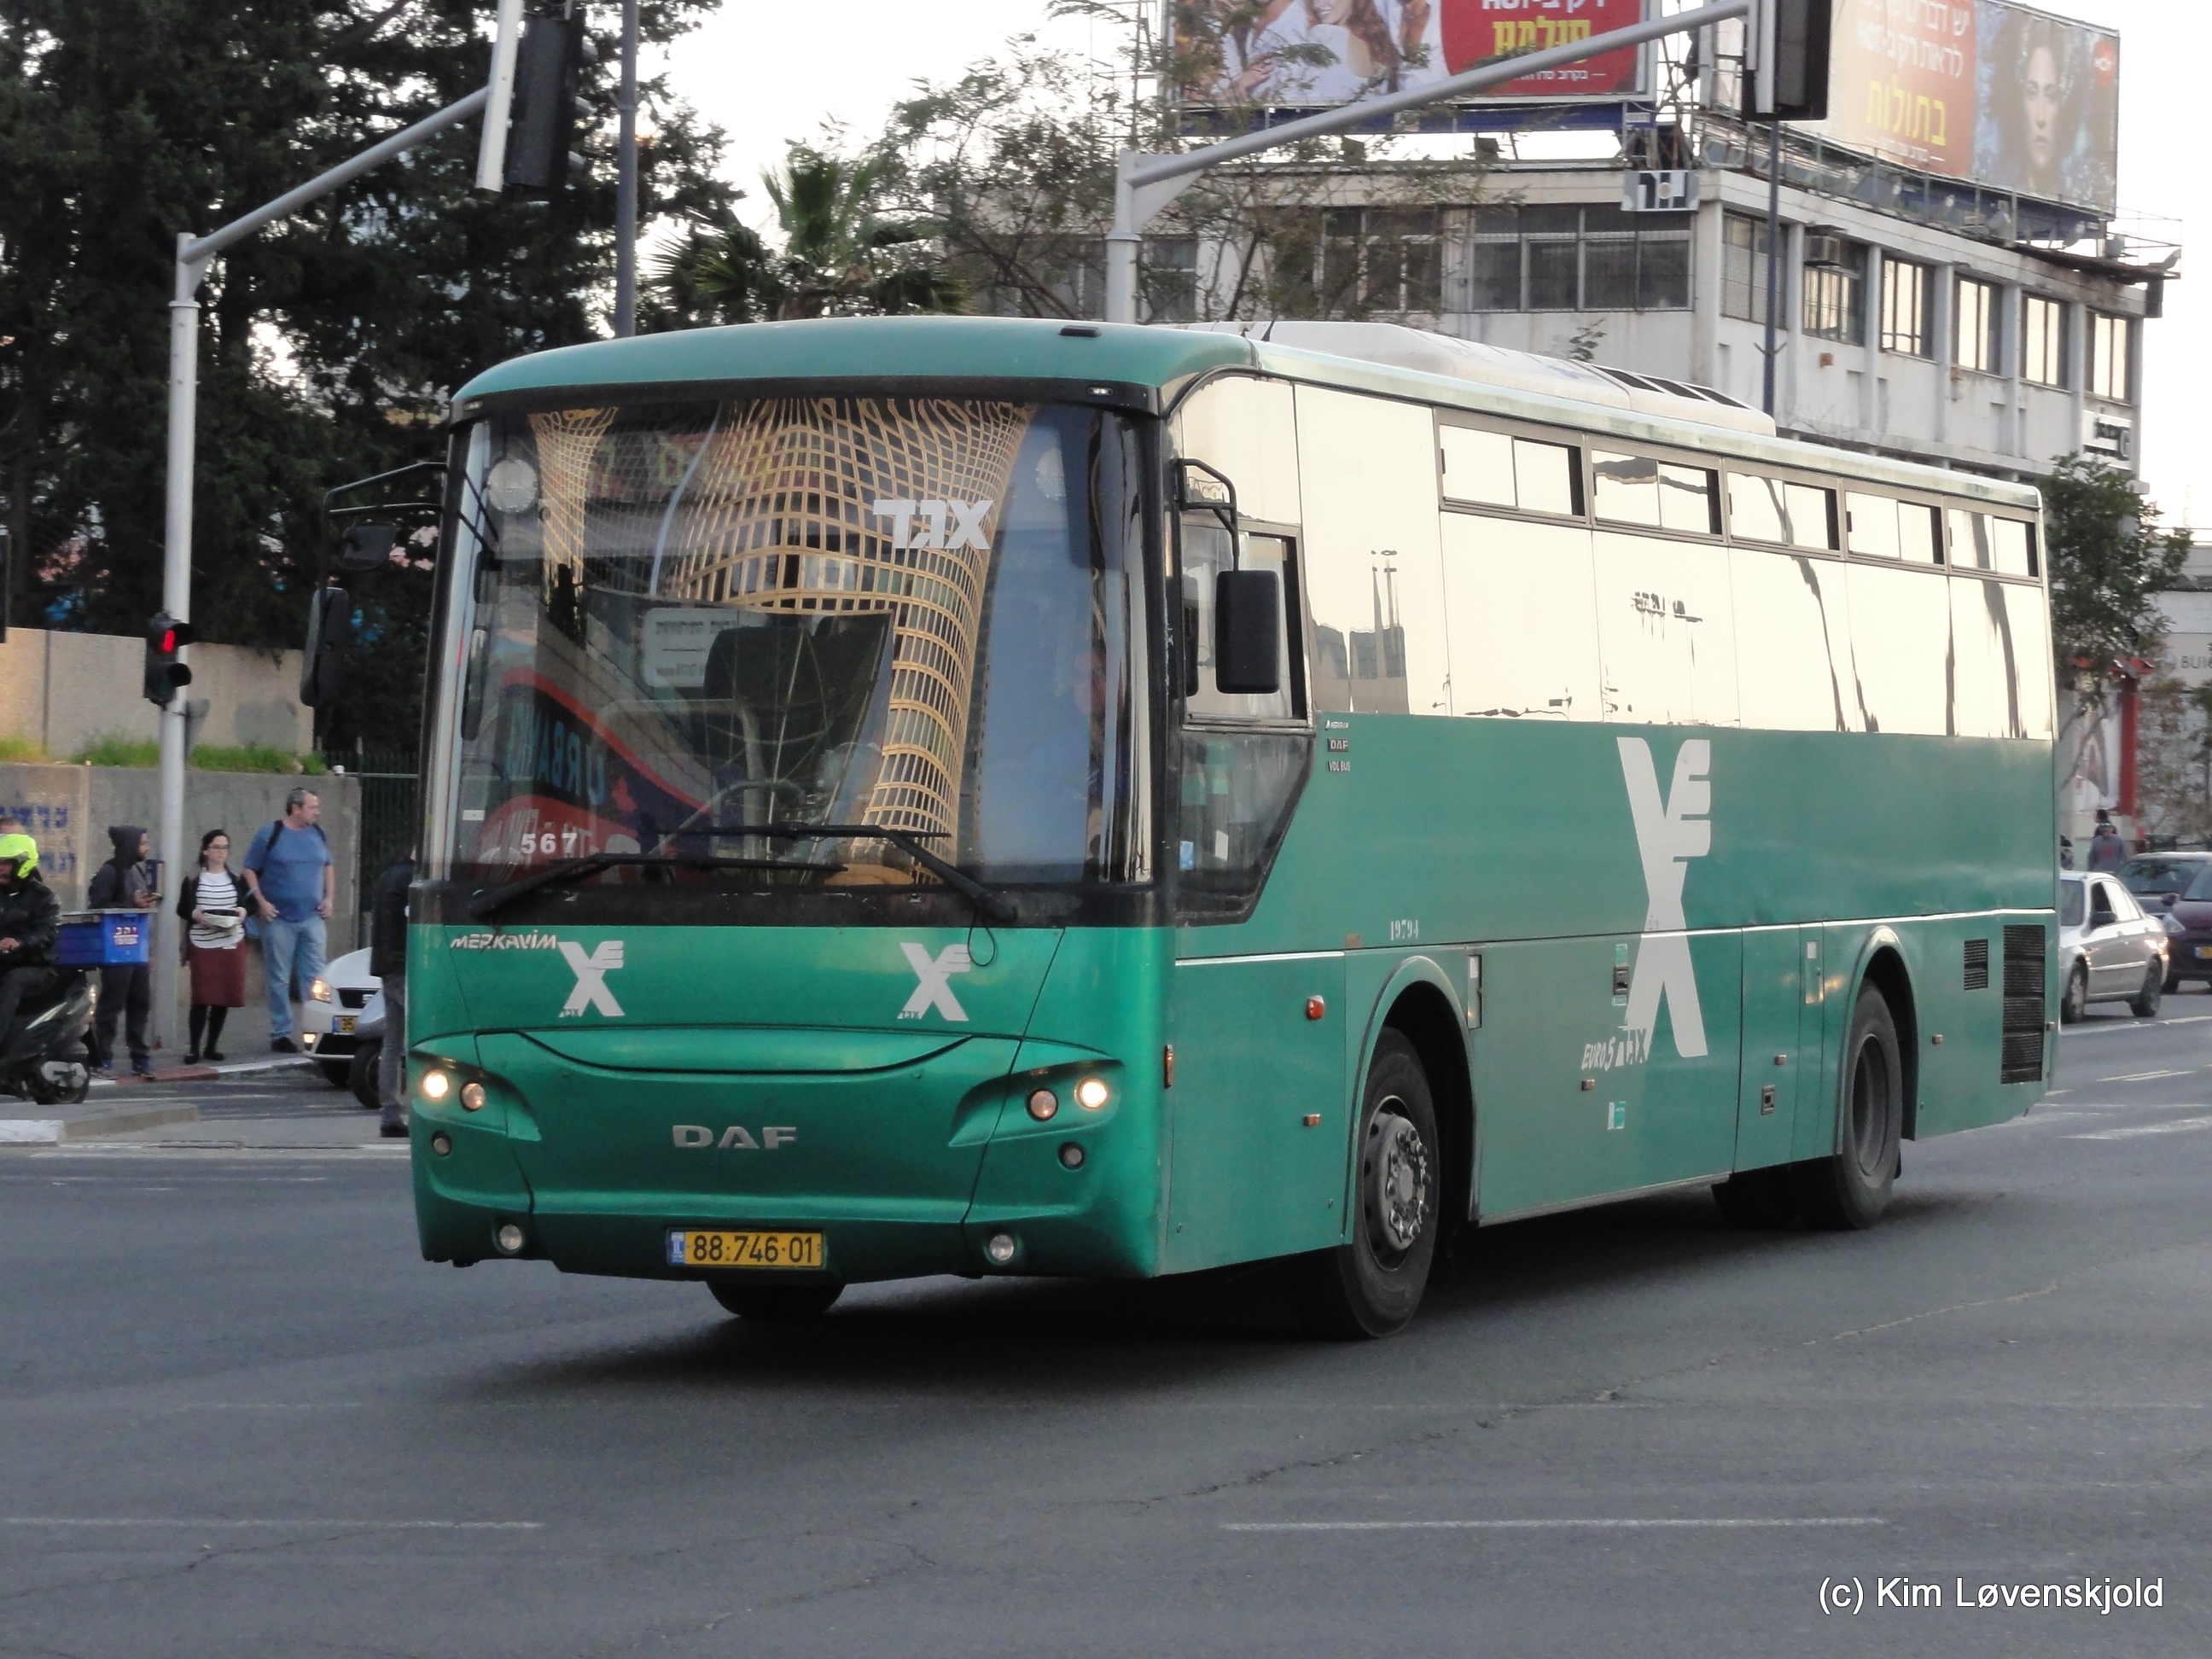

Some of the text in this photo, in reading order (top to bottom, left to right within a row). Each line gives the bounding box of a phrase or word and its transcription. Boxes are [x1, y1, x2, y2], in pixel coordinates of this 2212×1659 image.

[1866, 72, 1946, 147] בתולות
[1330, 739, 1348, 750] DAF
[521, 833, 578, 854] 567
[672, 1124, 798, 1150] DAF
